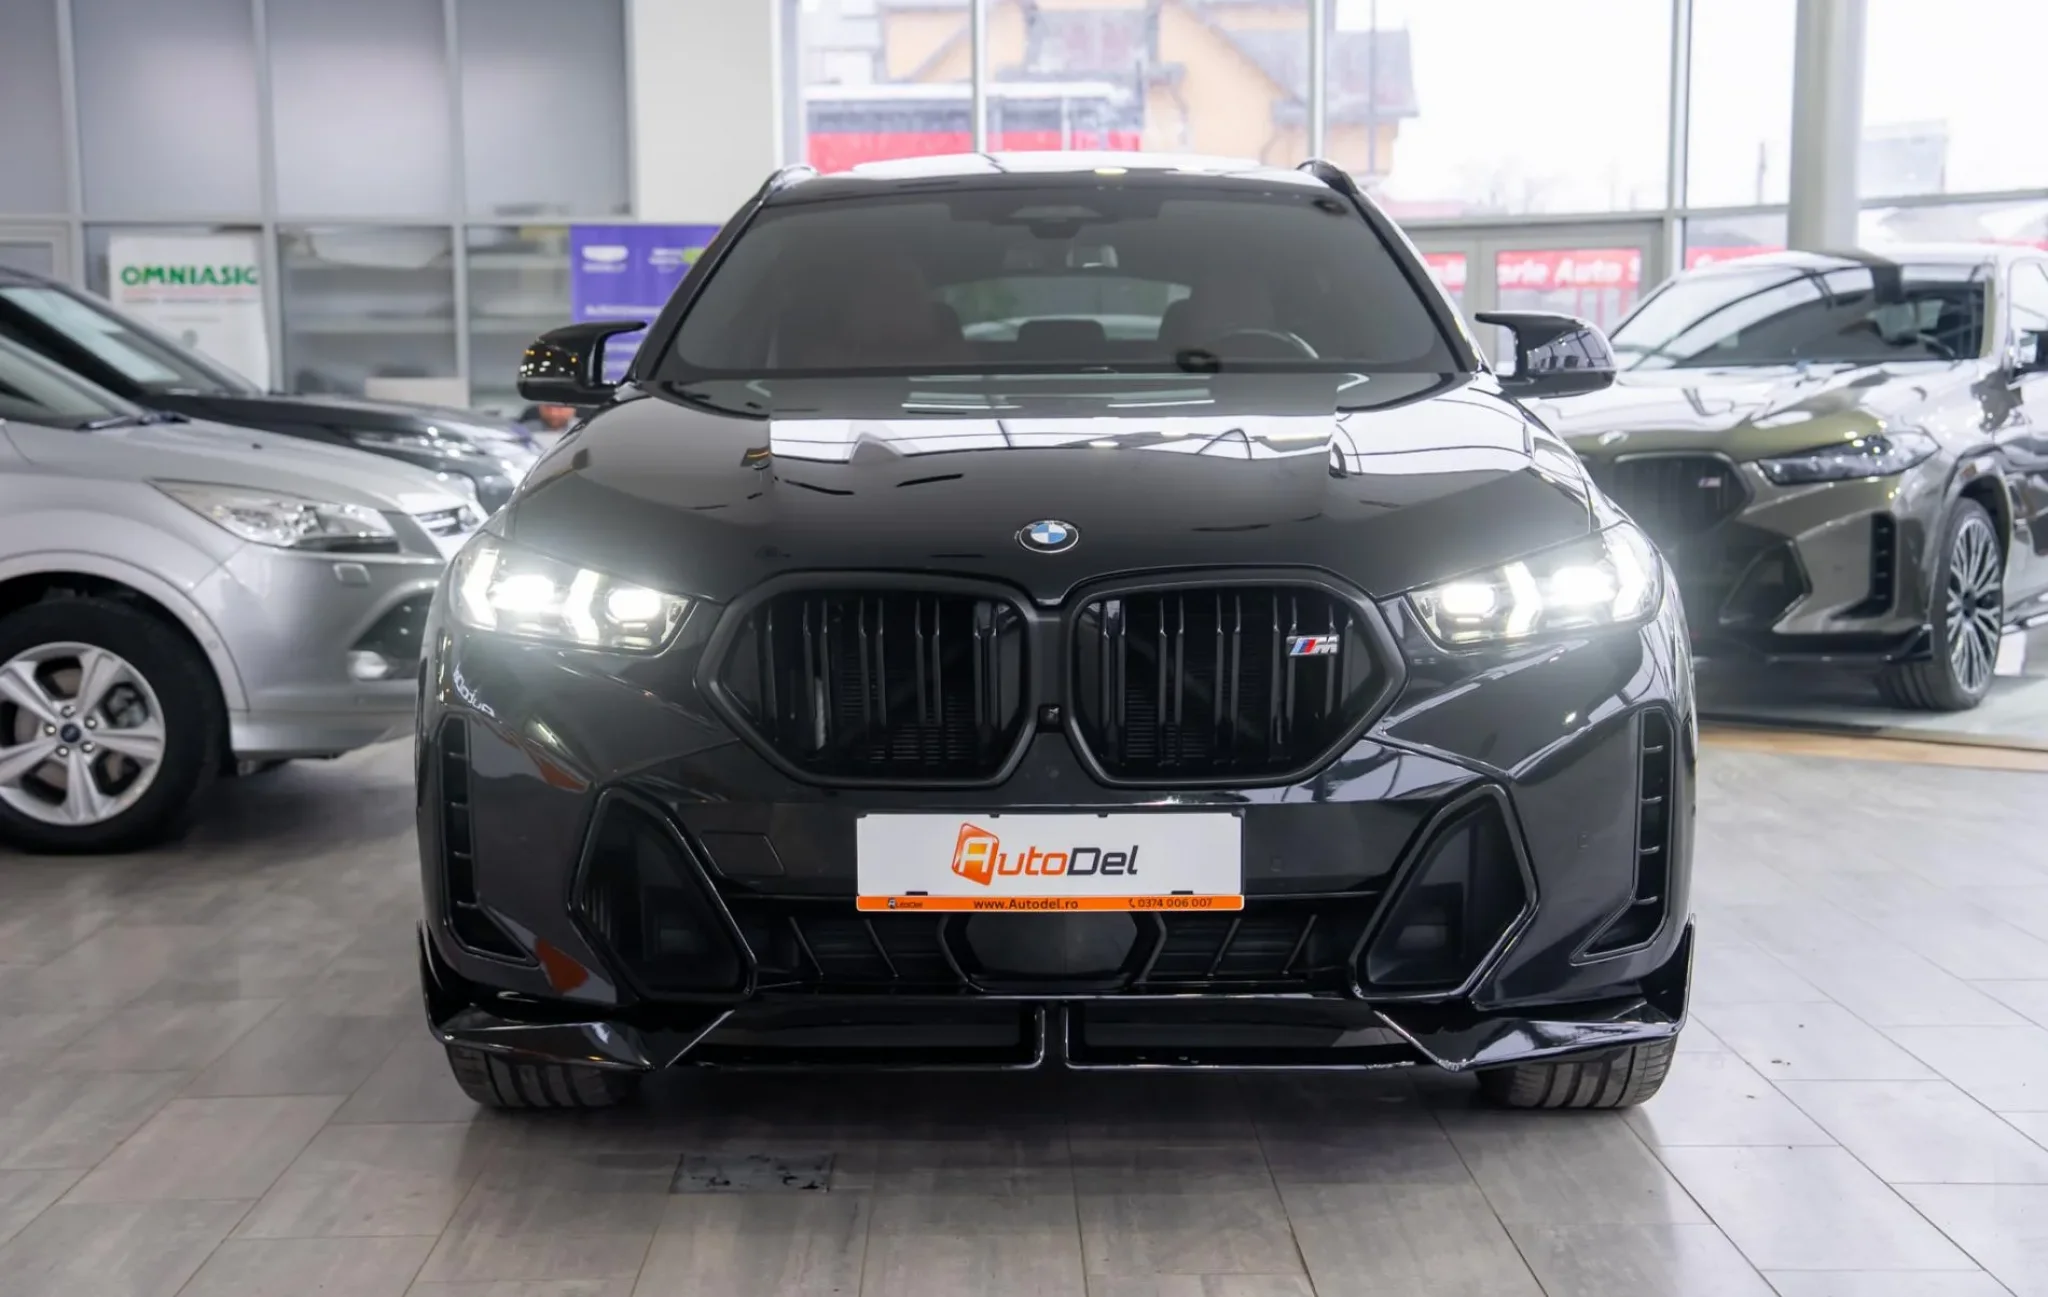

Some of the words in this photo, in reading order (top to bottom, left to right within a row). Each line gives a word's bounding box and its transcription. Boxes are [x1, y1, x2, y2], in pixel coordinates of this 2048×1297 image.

[957, 836, 1138, 876] AutoDel
[973, 899, 1078, 910] www.Autodel.ro
[1138, 898, 1163, 908] 0374
